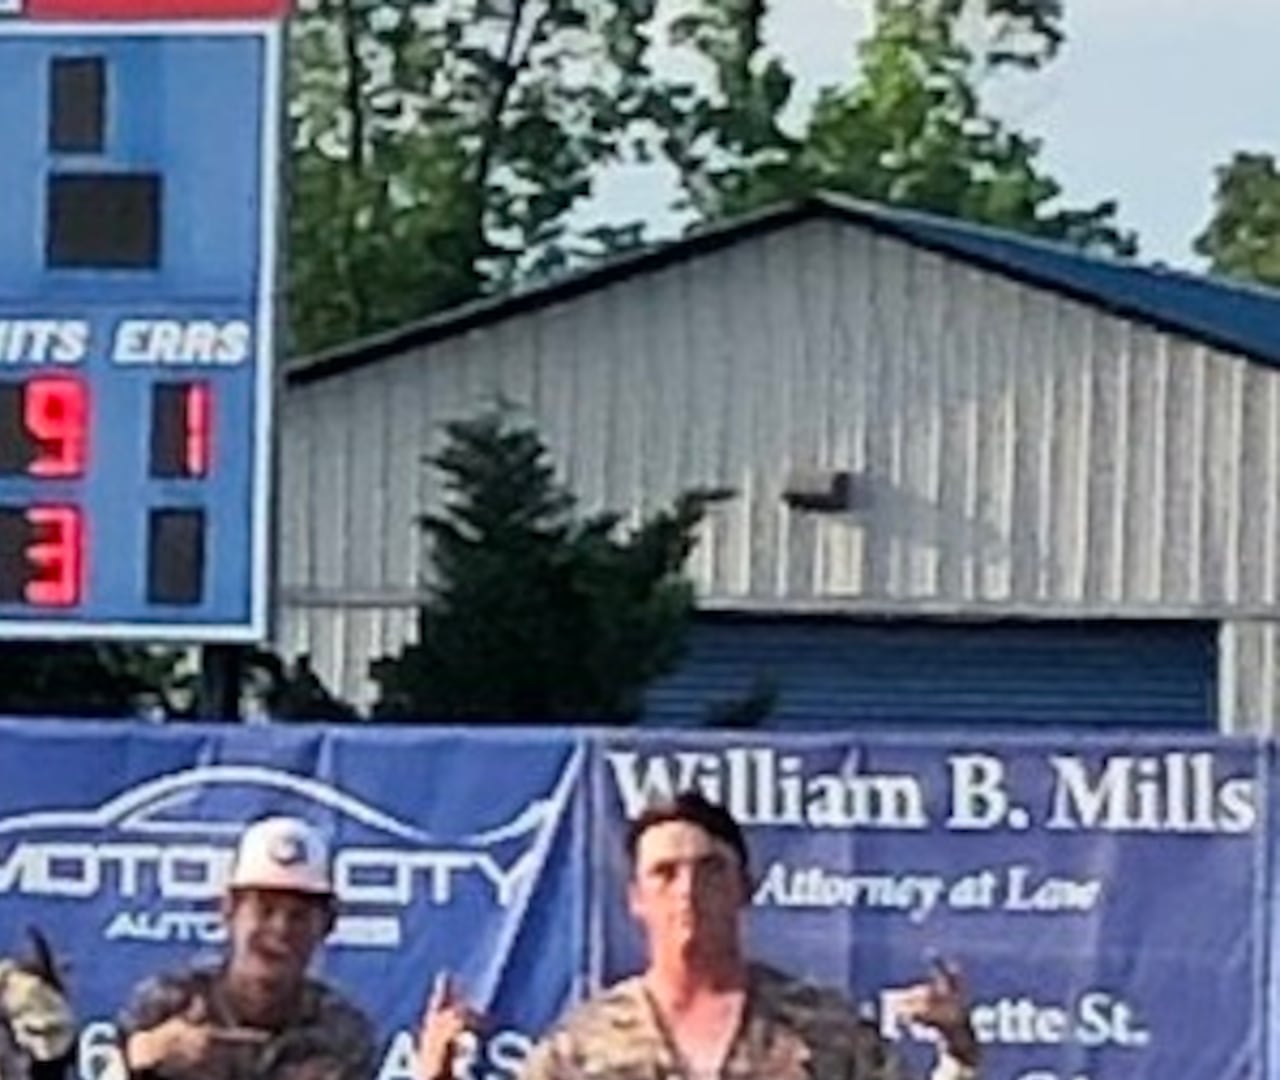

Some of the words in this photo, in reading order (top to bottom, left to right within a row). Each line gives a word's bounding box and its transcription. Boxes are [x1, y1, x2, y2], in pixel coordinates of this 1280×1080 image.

[112, 319, 252, 364] ERRS
[23, 507, 85, 602] 3
[604, 745, 929, 834] William
[945, 752, 1030, 831] B.
[1045, 752, 1258, 835] Mills
[750, 860, 946, 924] Attorney
[947, 869, 998, 909] at
[1002, 865, 1105, 912] Law
[1072, 992, 1152, 1046] St.
